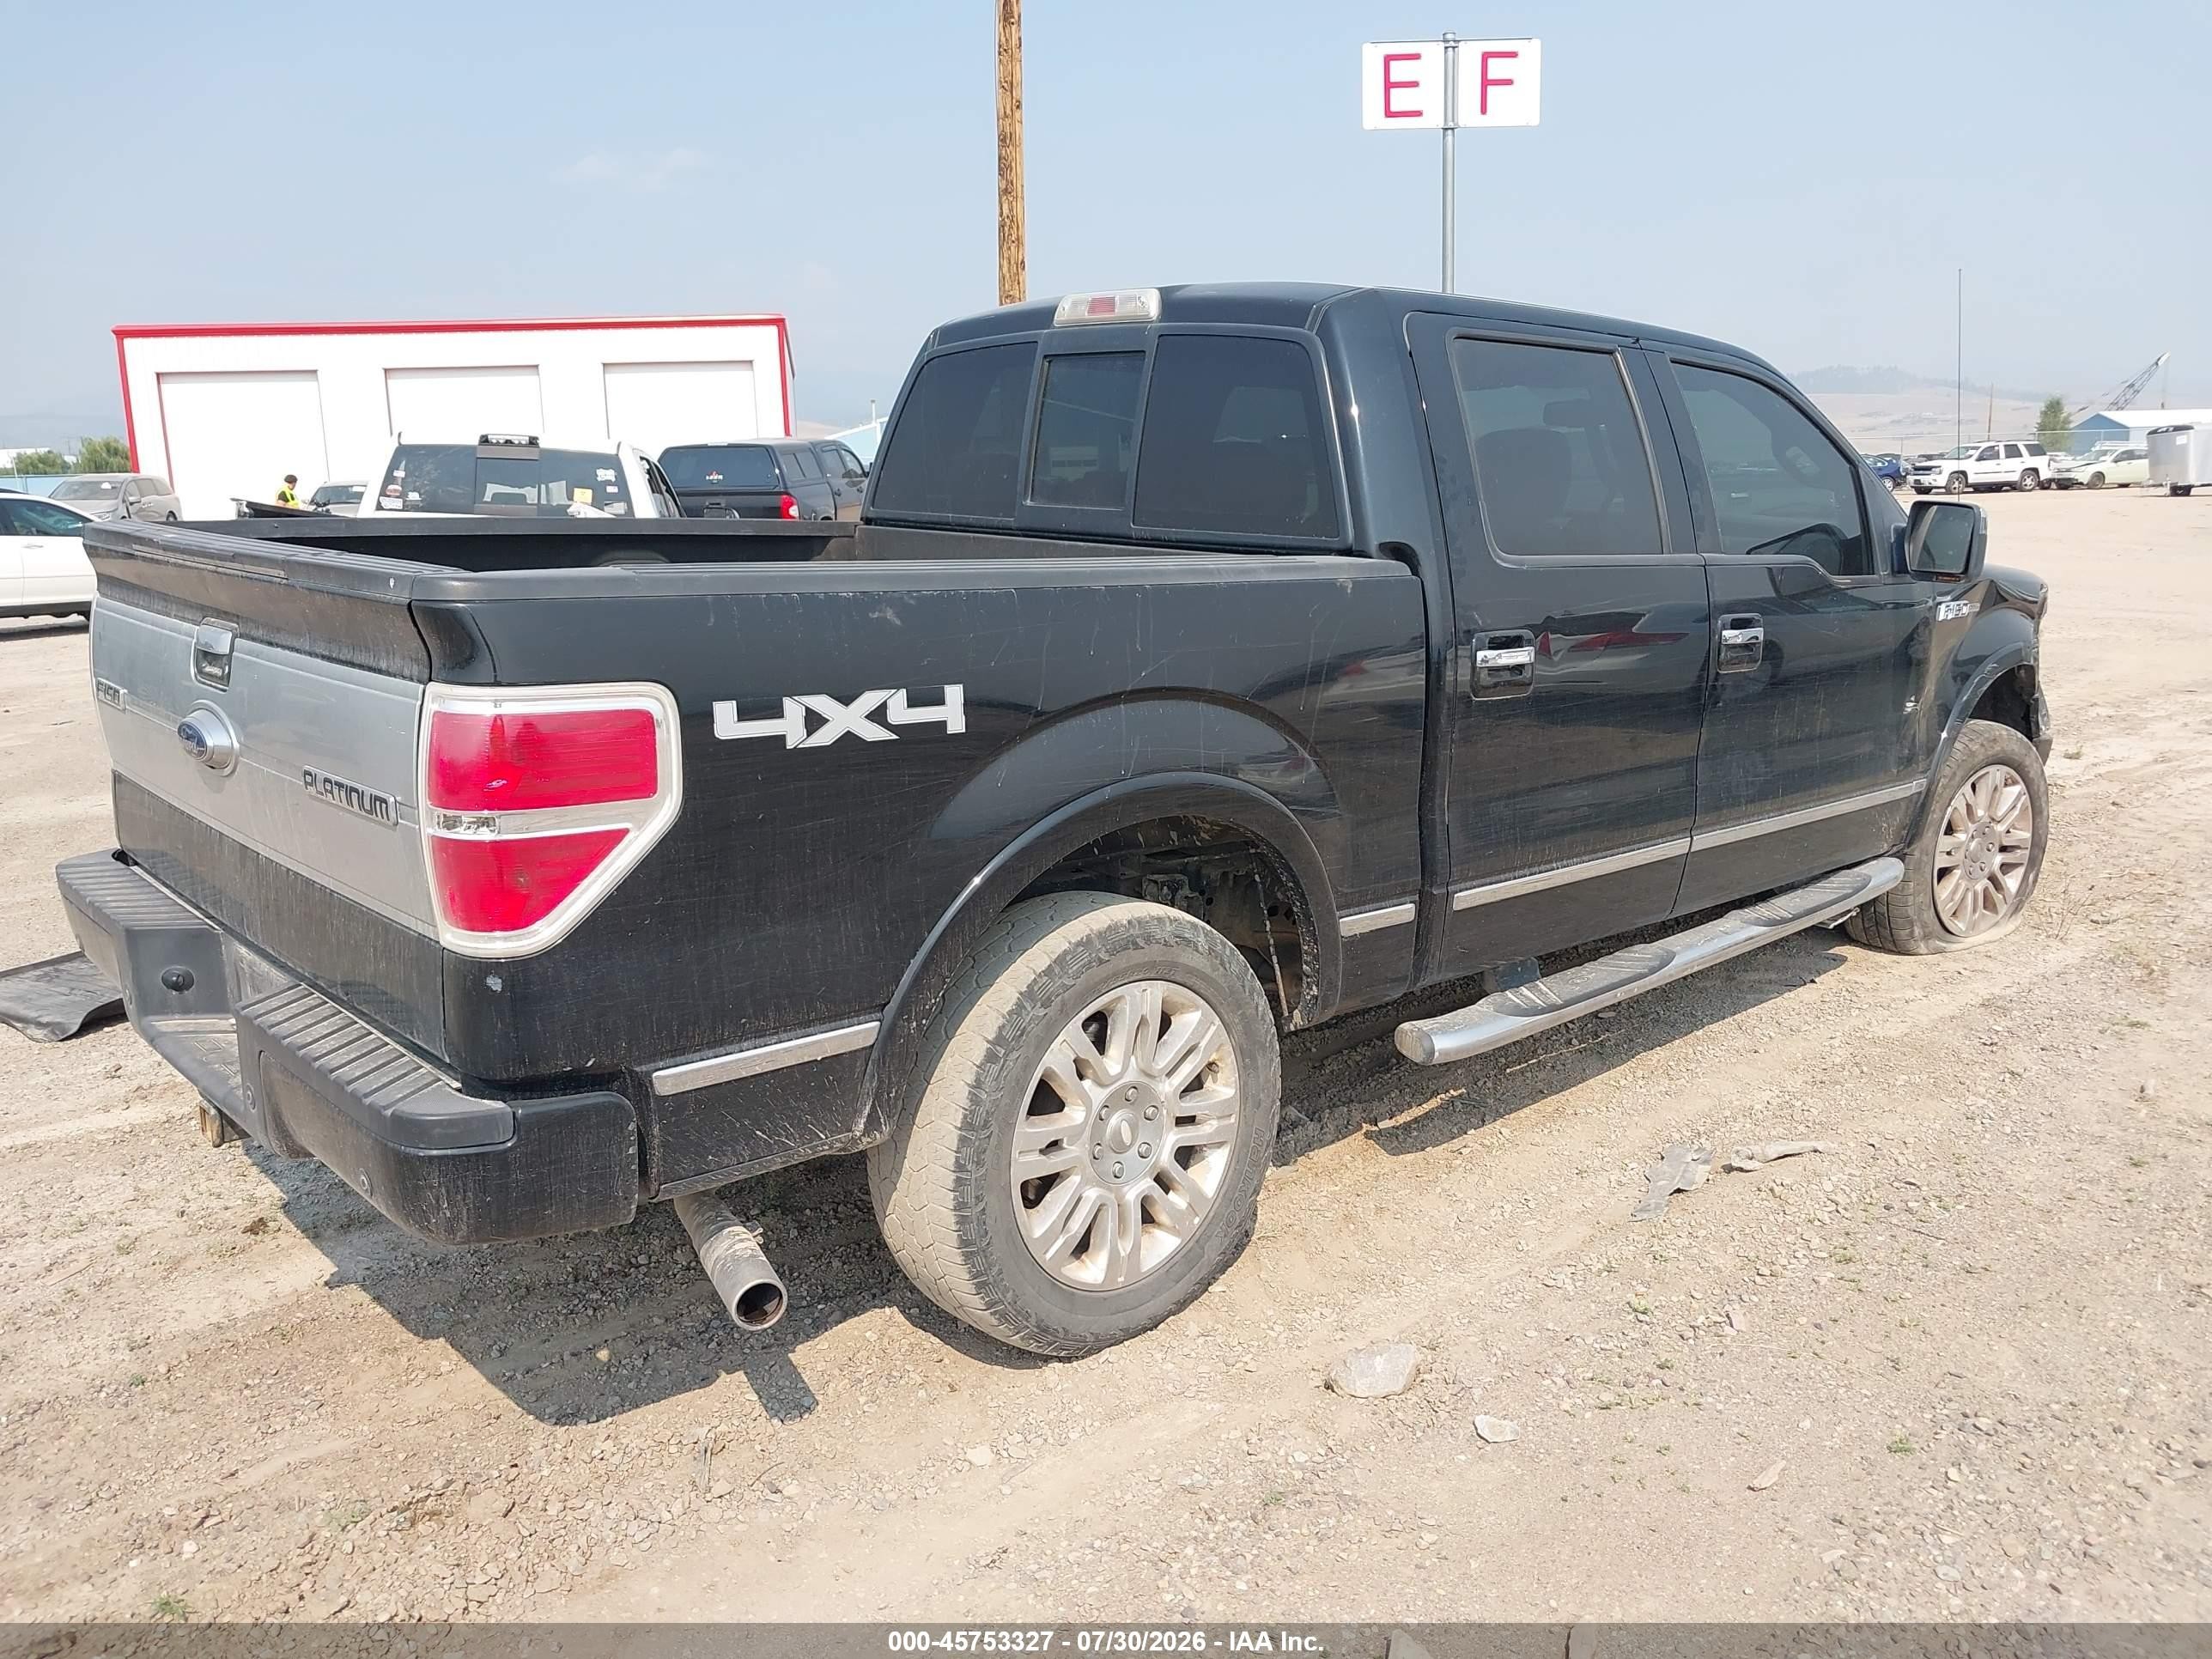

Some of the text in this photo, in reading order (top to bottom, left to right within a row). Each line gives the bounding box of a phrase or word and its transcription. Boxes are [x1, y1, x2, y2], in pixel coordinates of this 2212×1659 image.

[1383, 52, 1423, 118] E
[1480, 51, 1519, 116] F
[302, 768, 391, 822] PLATINUM
